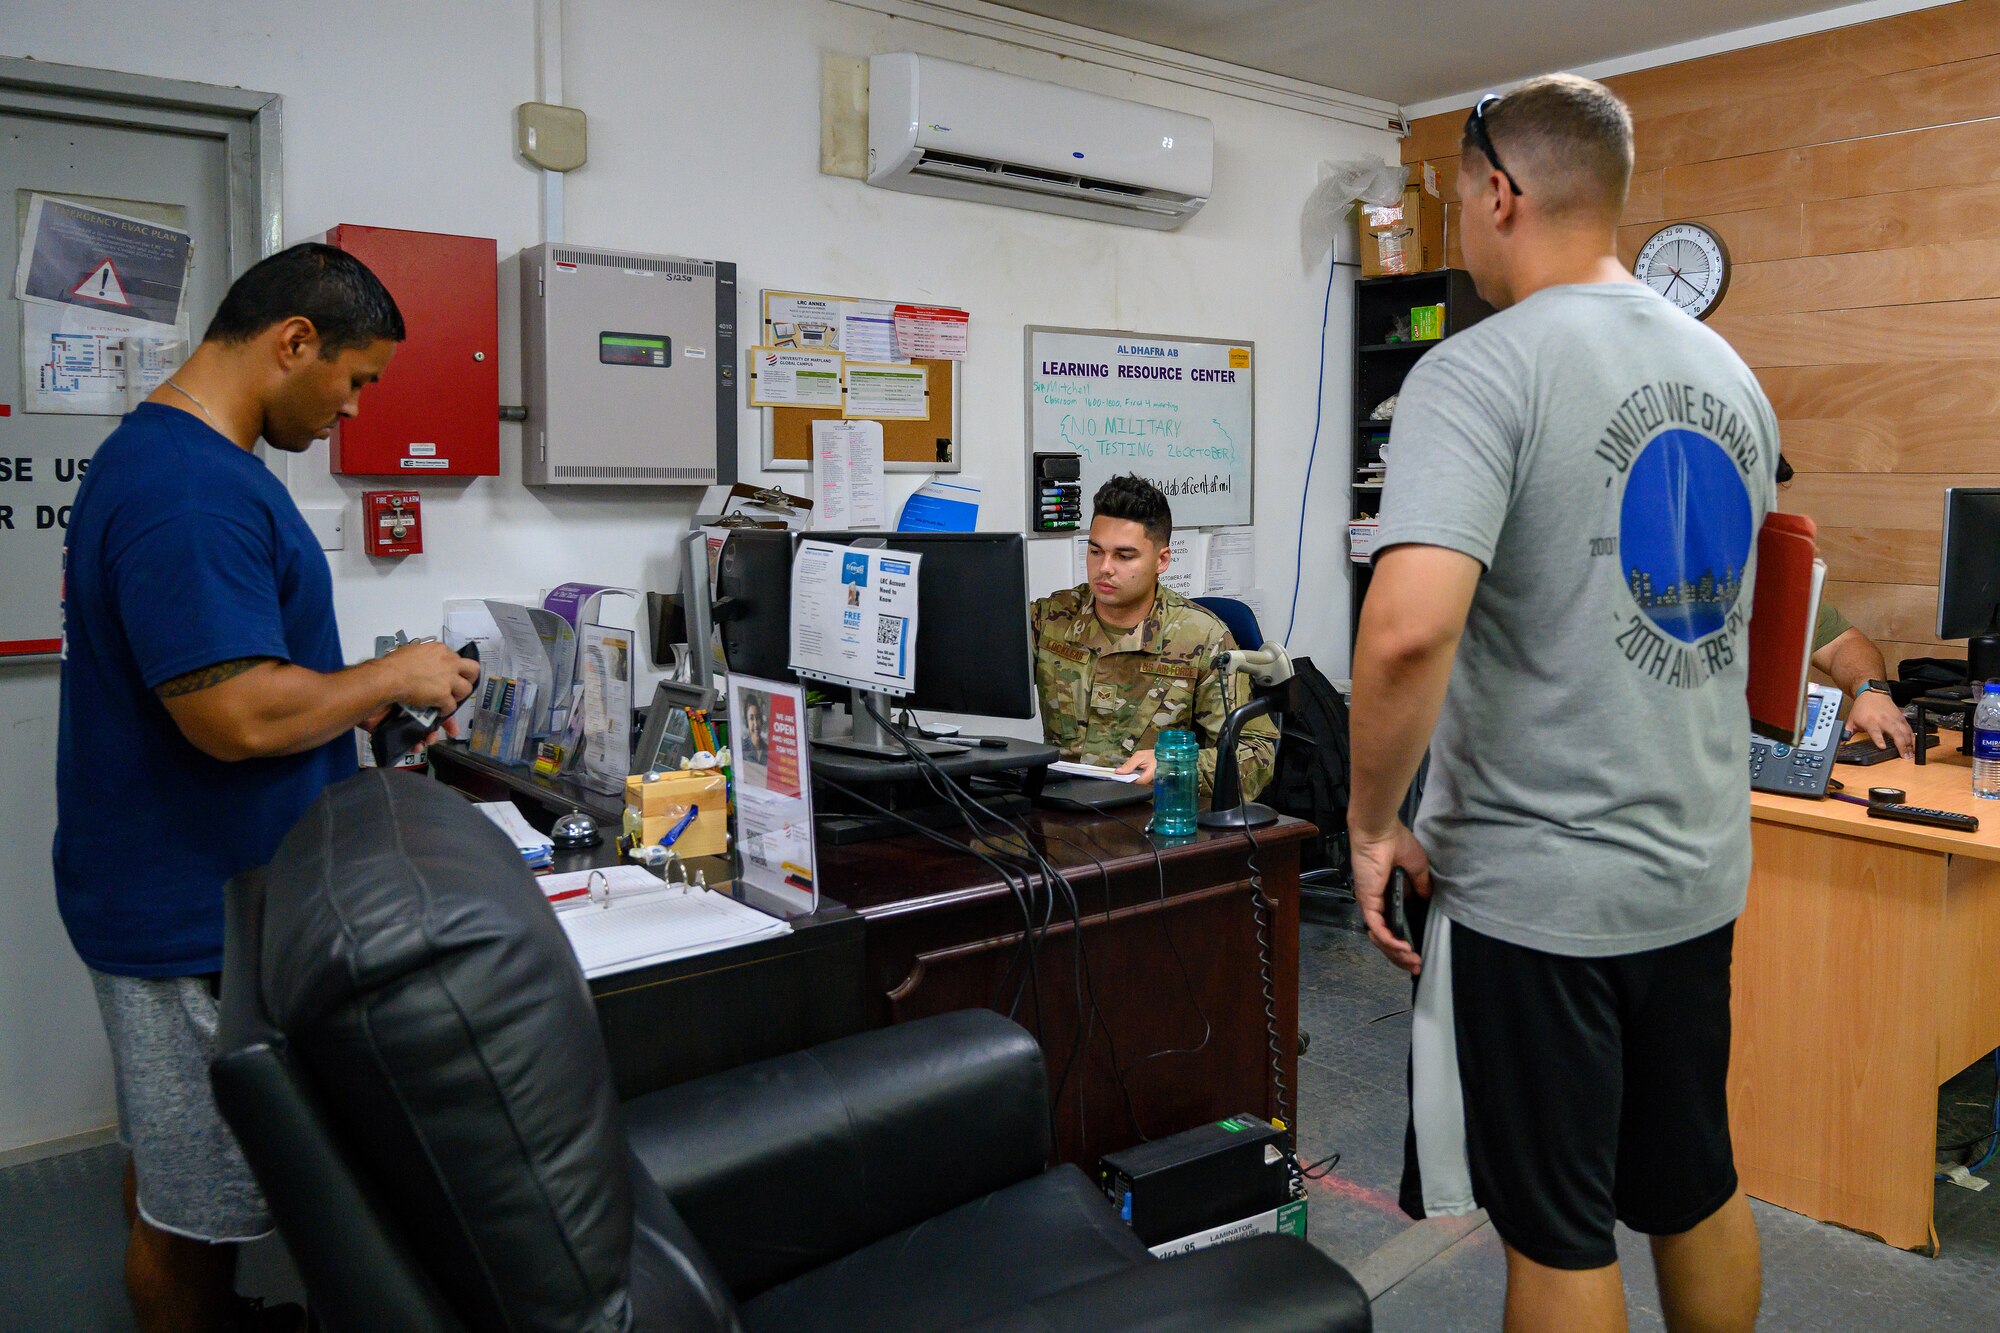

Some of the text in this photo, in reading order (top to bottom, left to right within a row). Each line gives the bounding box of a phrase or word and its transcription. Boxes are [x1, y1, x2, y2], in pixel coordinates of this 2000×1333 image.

[1162, 137, 1173, 148] 23
[121, 222, 148, 235] EVAC
[151, 229, 177, 242] PLAN
[1117, 345, 1179, 358] AL DHAFRA AB
[1042, 361, 1236, 383] LEARNING RESOURCE CENTER
[1071, 416, 1182, 439] NO MILITARY
[1595, 384, 1664, 473] UNITED
[1659, 381, 1698, 425] WE
[1096, 439, 1154, 458] TESTING
[880, 577, 888, 585] LRC
[844, 610, 861, 621] FREE
[843, 619, 860, 628] MUSIC
[1616, 614, 1674, 681] 20TH
[1157, 663, 1168, 674] AIR
[1170, 665, 1194, 677] FORCE
[775, 712, 795, 724] WE ARE
[773, 721, 796, 736] OPEN
[1209, 1223, 1253, 1242] LAMINATOR
